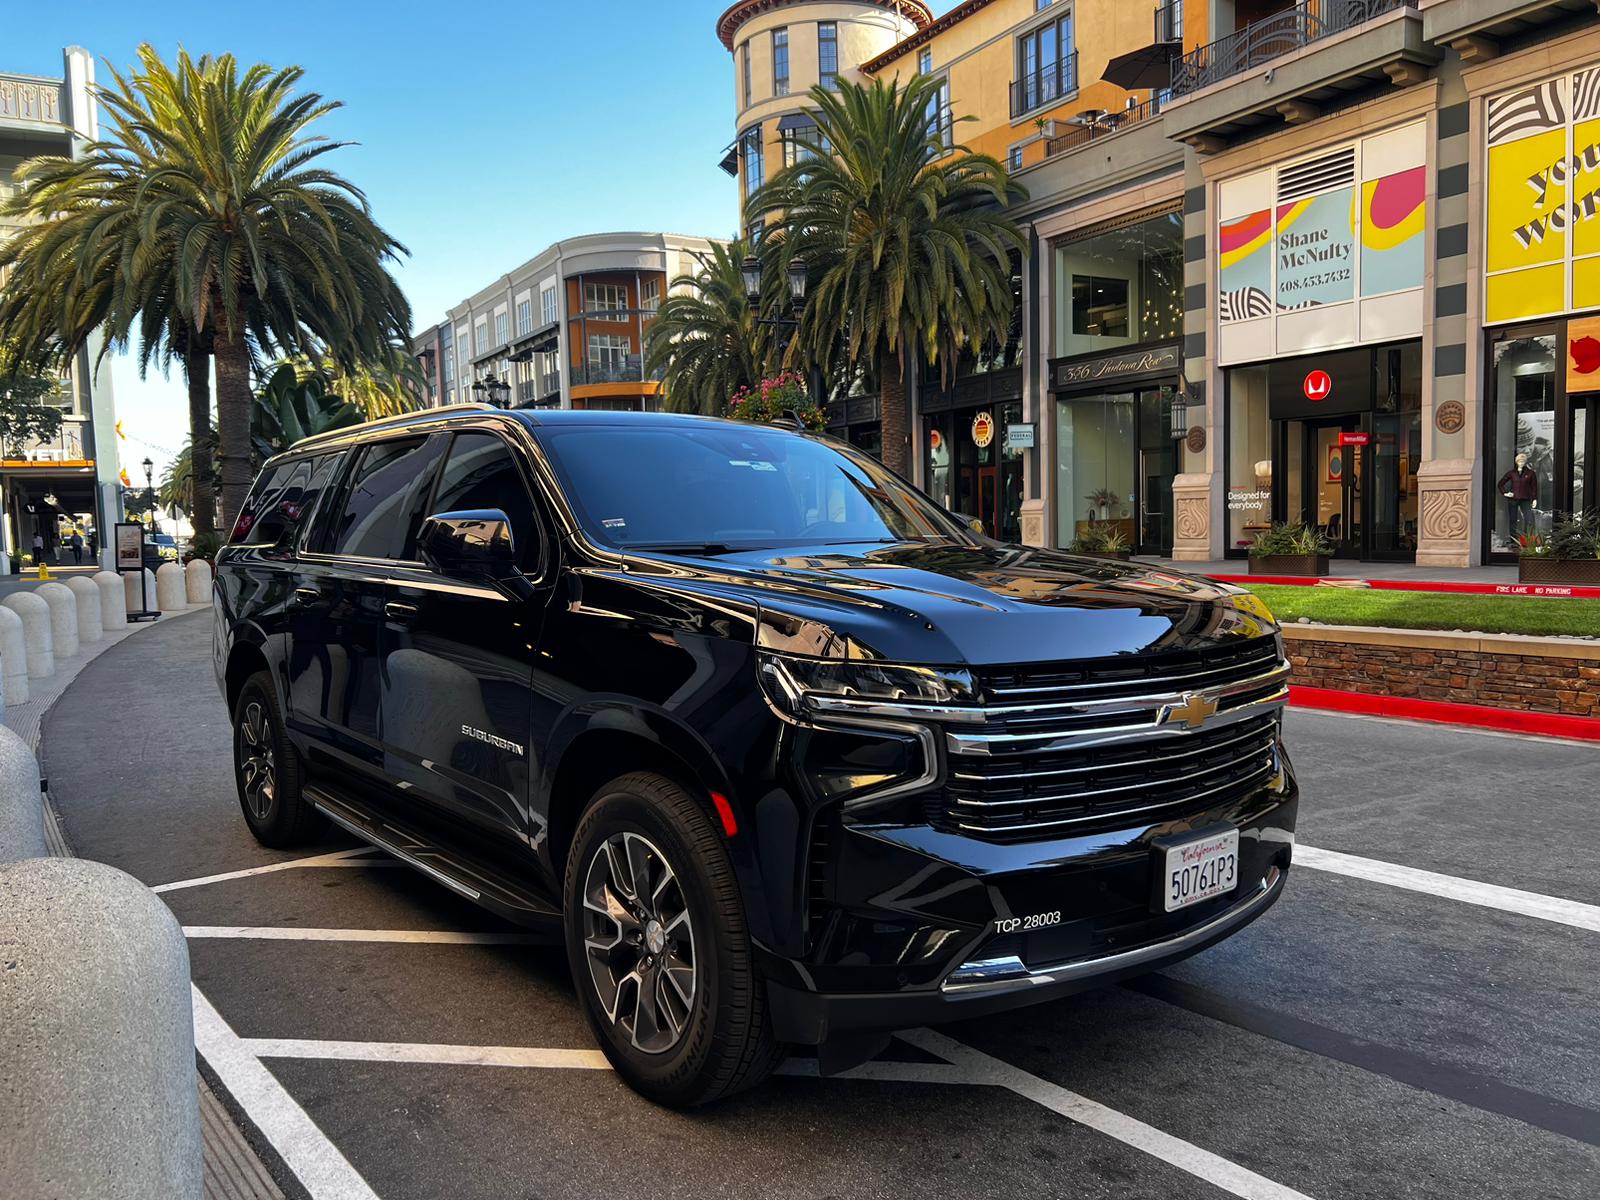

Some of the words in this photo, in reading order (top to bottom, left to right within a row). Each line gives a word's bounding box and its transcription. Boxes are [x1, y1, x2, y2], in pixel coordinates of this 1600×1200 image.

[1280, 228, 1329, 251] Shane
[1280, 242, 1353, 271] McNulty
[1278, 268, 1351, 293] 408.453.7432
[24, 448, 69, 462] YETI
[1228, 491, 1260, 501] Designed
[1260, 490, 1271, 500] for
[1228, 501, 1263, 511] everybody
[1496, 585, 1510, 593] FIRE
[1511, 586, 1528, 594] LANE
[1545, 587, 1572, 595] PARKING
[461, 724, 524, 756] SUBURBAN
[1181, 842, 1229, 863] California
[1171, 853, 1235, 901] 50761P3
[994, 917, 1021, 934] TCP
[1023, 910, 1061, 930] 28003
